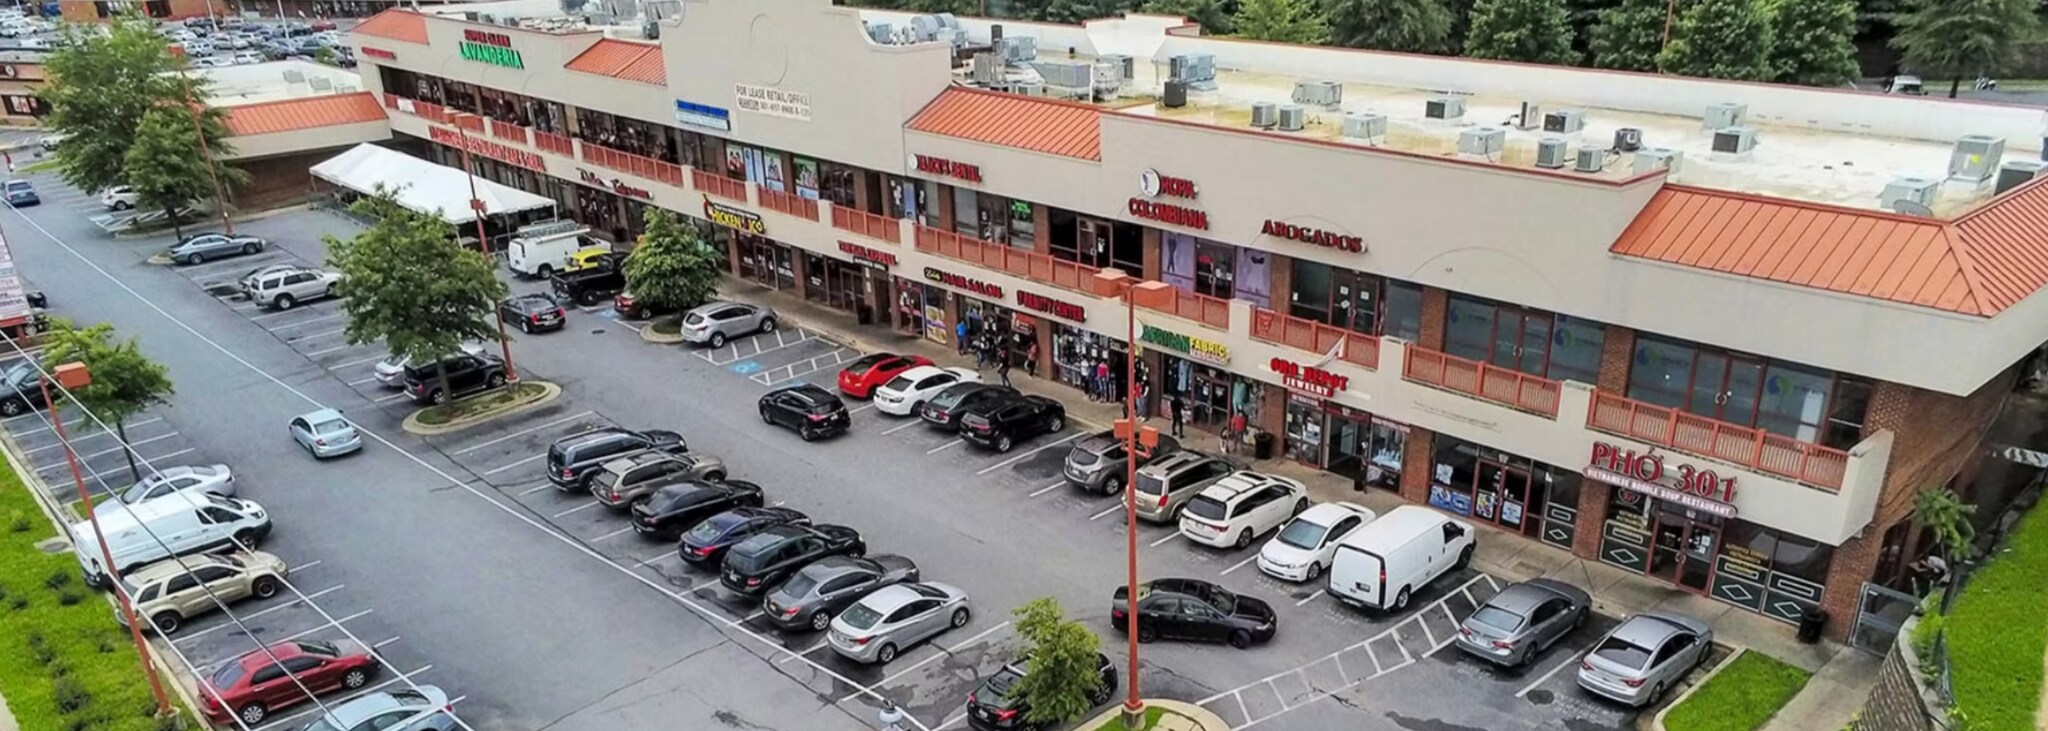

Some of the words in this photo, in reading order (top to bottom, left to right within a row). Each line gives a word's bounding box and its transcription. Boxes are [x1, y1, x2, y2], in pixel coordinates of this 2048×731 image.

[459, 41, 524, 69] LAVANDERIA
[1161, 175, 1196, 199] ROPA
[1128, 198, 1208, 230] COLOMBIANA
[1261, 219, 1364, 253] ABOGADOS
[943, 272, 967, 290] HAIR
[968, 278, 1003, 299] SALON
[1143, 324, 1191, 354] AFRICAN
[1270, 357, 1299, 378] ORO
[1303, 366, 1349, 391] DEPOT
[1286, 376, 1329, 396] JEWELRY
[1587, 469, 1629, 487] VIETNAMESE
[1632, 481, 1658, 496] NOODLE
[1661, 488, 1680, 501] SOUP
[1682, 495, 1730, 516] RESTAURANT
[1674, 463, 1737, 502] 301
